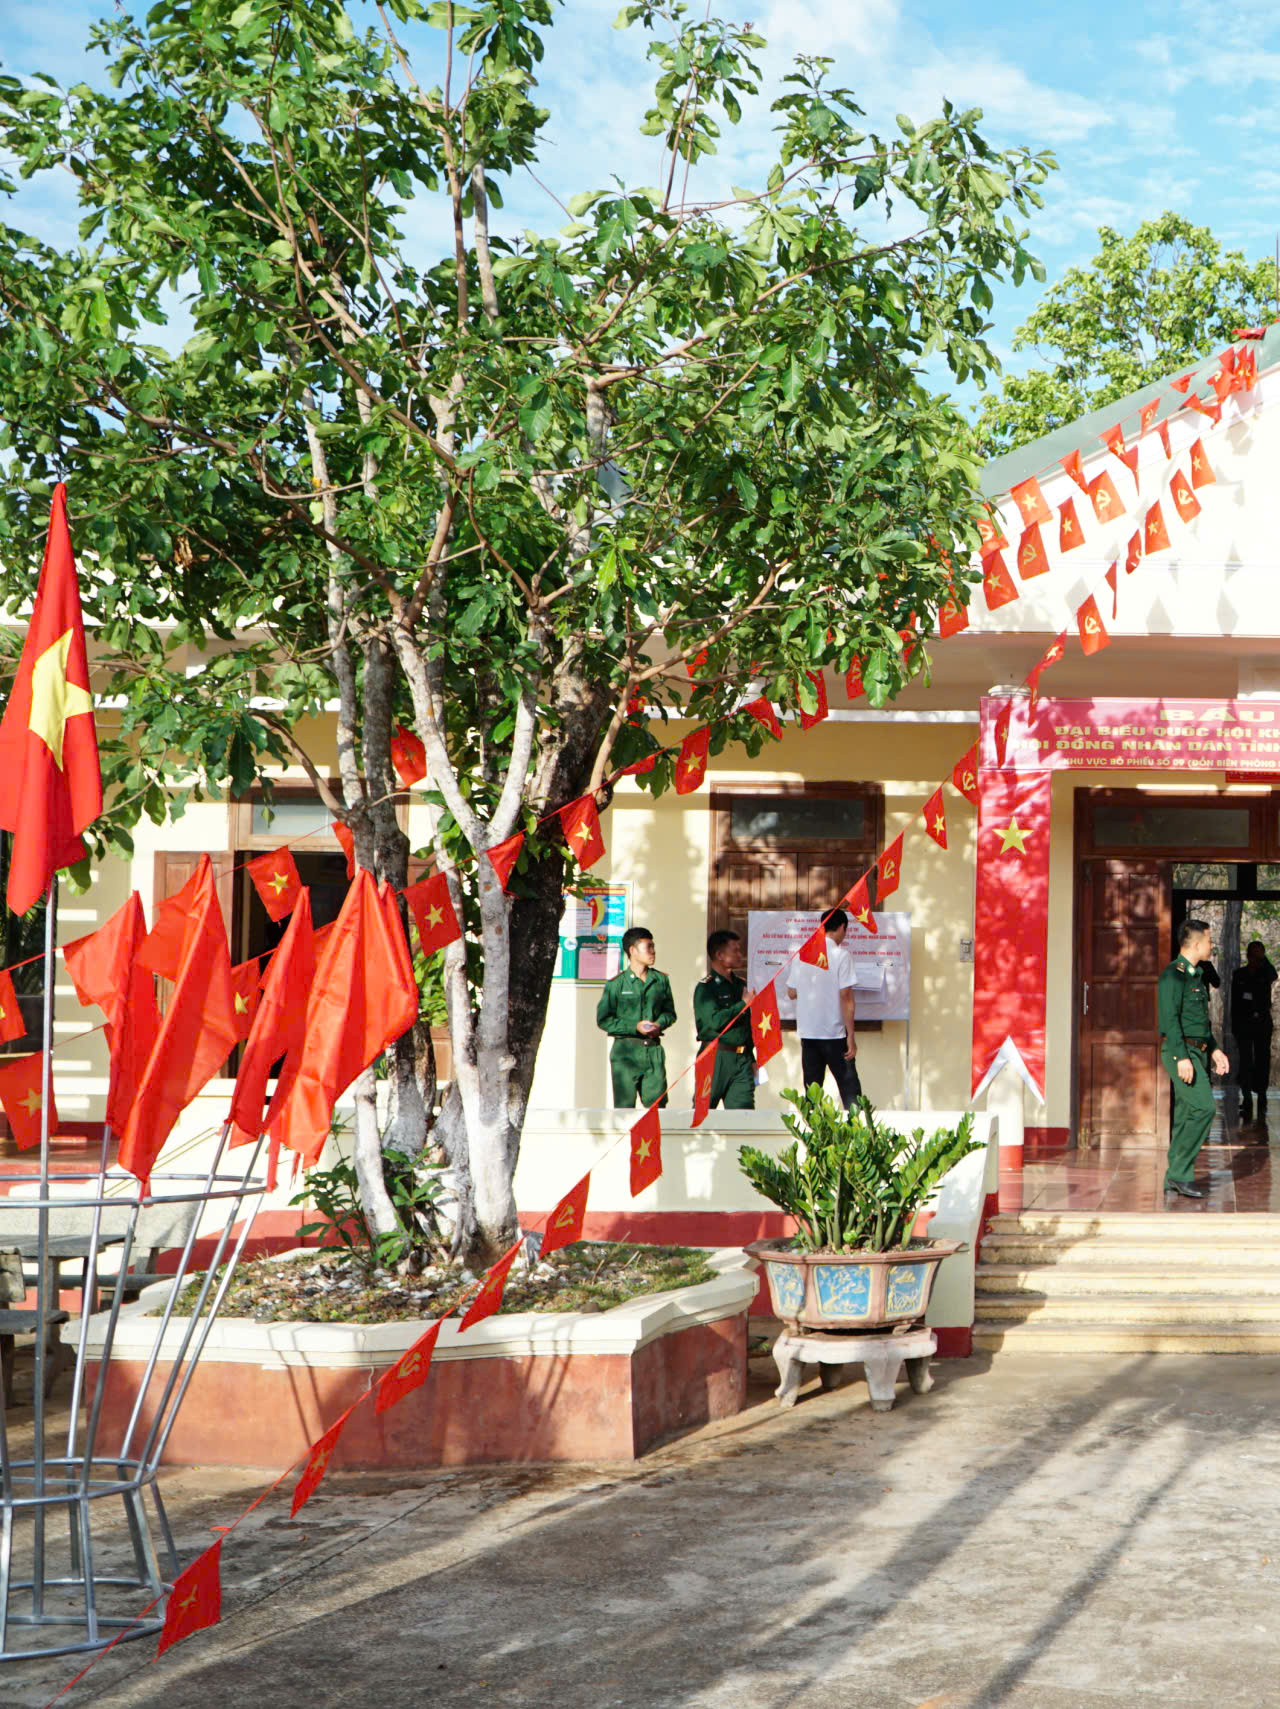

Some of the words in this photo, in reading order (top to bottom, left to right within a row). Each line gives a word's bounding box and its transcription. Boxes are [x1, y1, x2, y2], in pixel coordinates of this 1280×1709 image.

[1055, 726, 1091, 738] ĐẠI
[1098, 723, 1146, 736] BIỂU
[1153, 725, 1209, 738] QUỐC
[1217, 727, 1252, 740] HỘI
[1056, 737, 1115, 750] ĐỒNG
[1122, 739, 1181, 751] NHÂN
[1188, 740, 1232, 752] DÂN
[1086, 757, 1107, 767] VỰC
